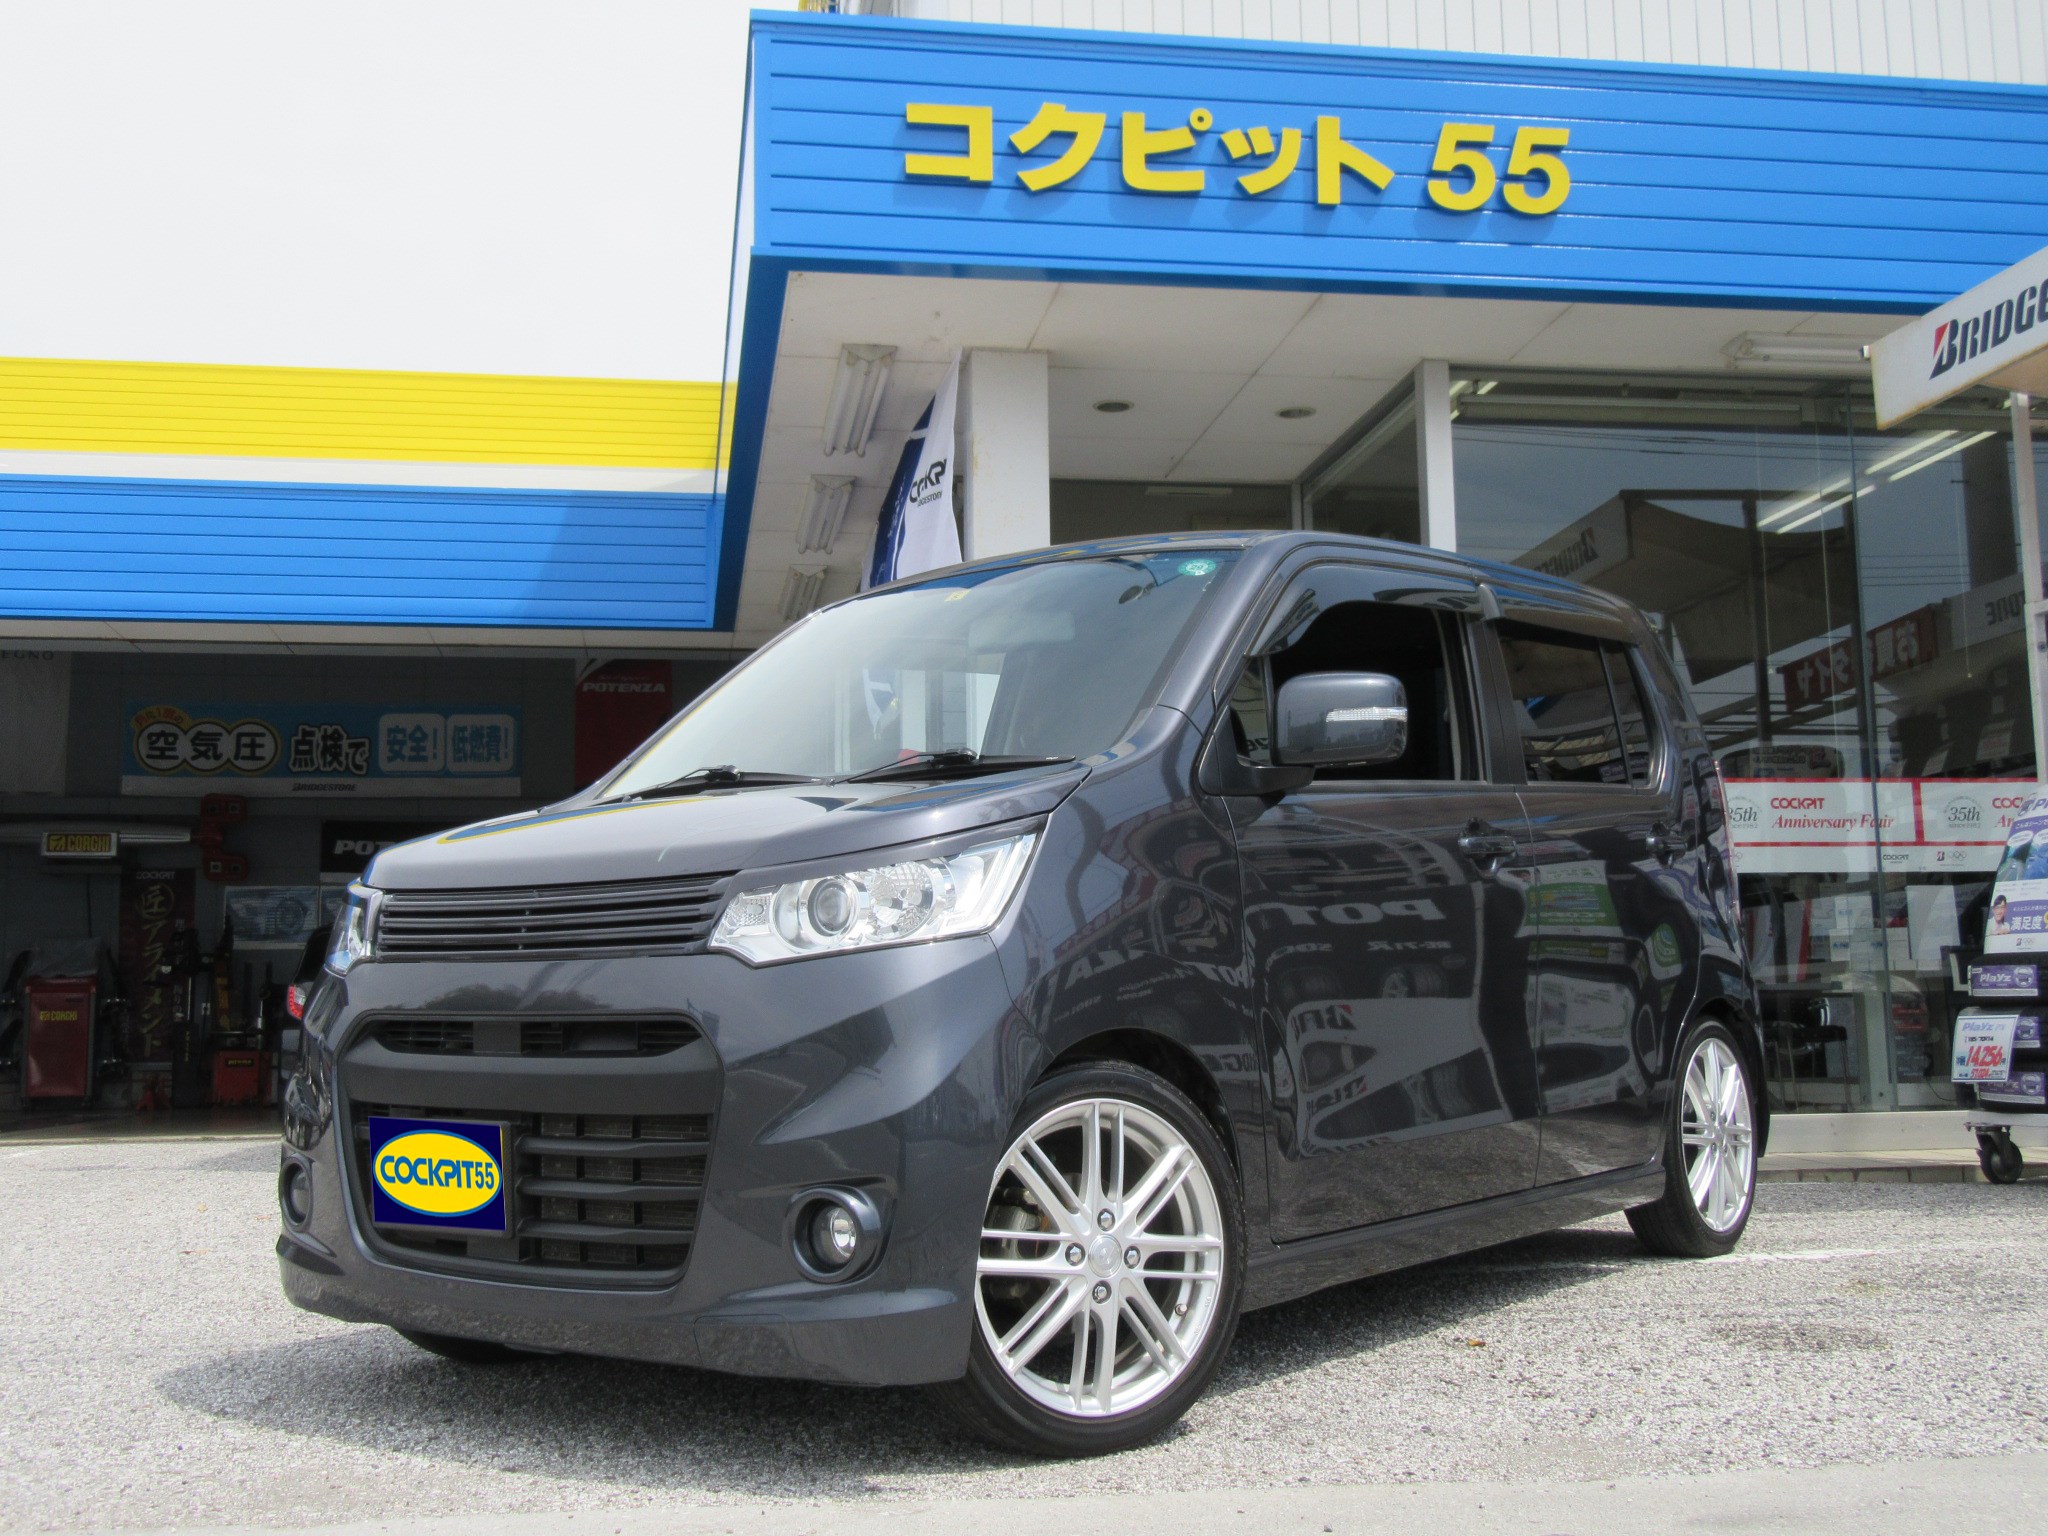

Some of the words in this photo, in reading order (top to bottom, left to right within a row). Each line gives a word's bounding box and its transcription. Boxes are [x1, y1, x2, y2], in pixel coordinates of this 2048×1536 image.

[905, 102, 1396, 205] コクピット
[1427, 122, 1571, 215] 55
[582, 682, 666, 693] POTENZA
[146, 729, 267, 761] 空気圧
[292, 726, 369, 773] 点検で
[292, 783, 358, 792] BRIDGESTONE
[1770, 797, 1826, 810] COCKPIT
[1771, 813, 1857, 832] Anniversary
[1947, 806, 1981, 822] 35th
[67, 834, 111, 852] CORGHI
